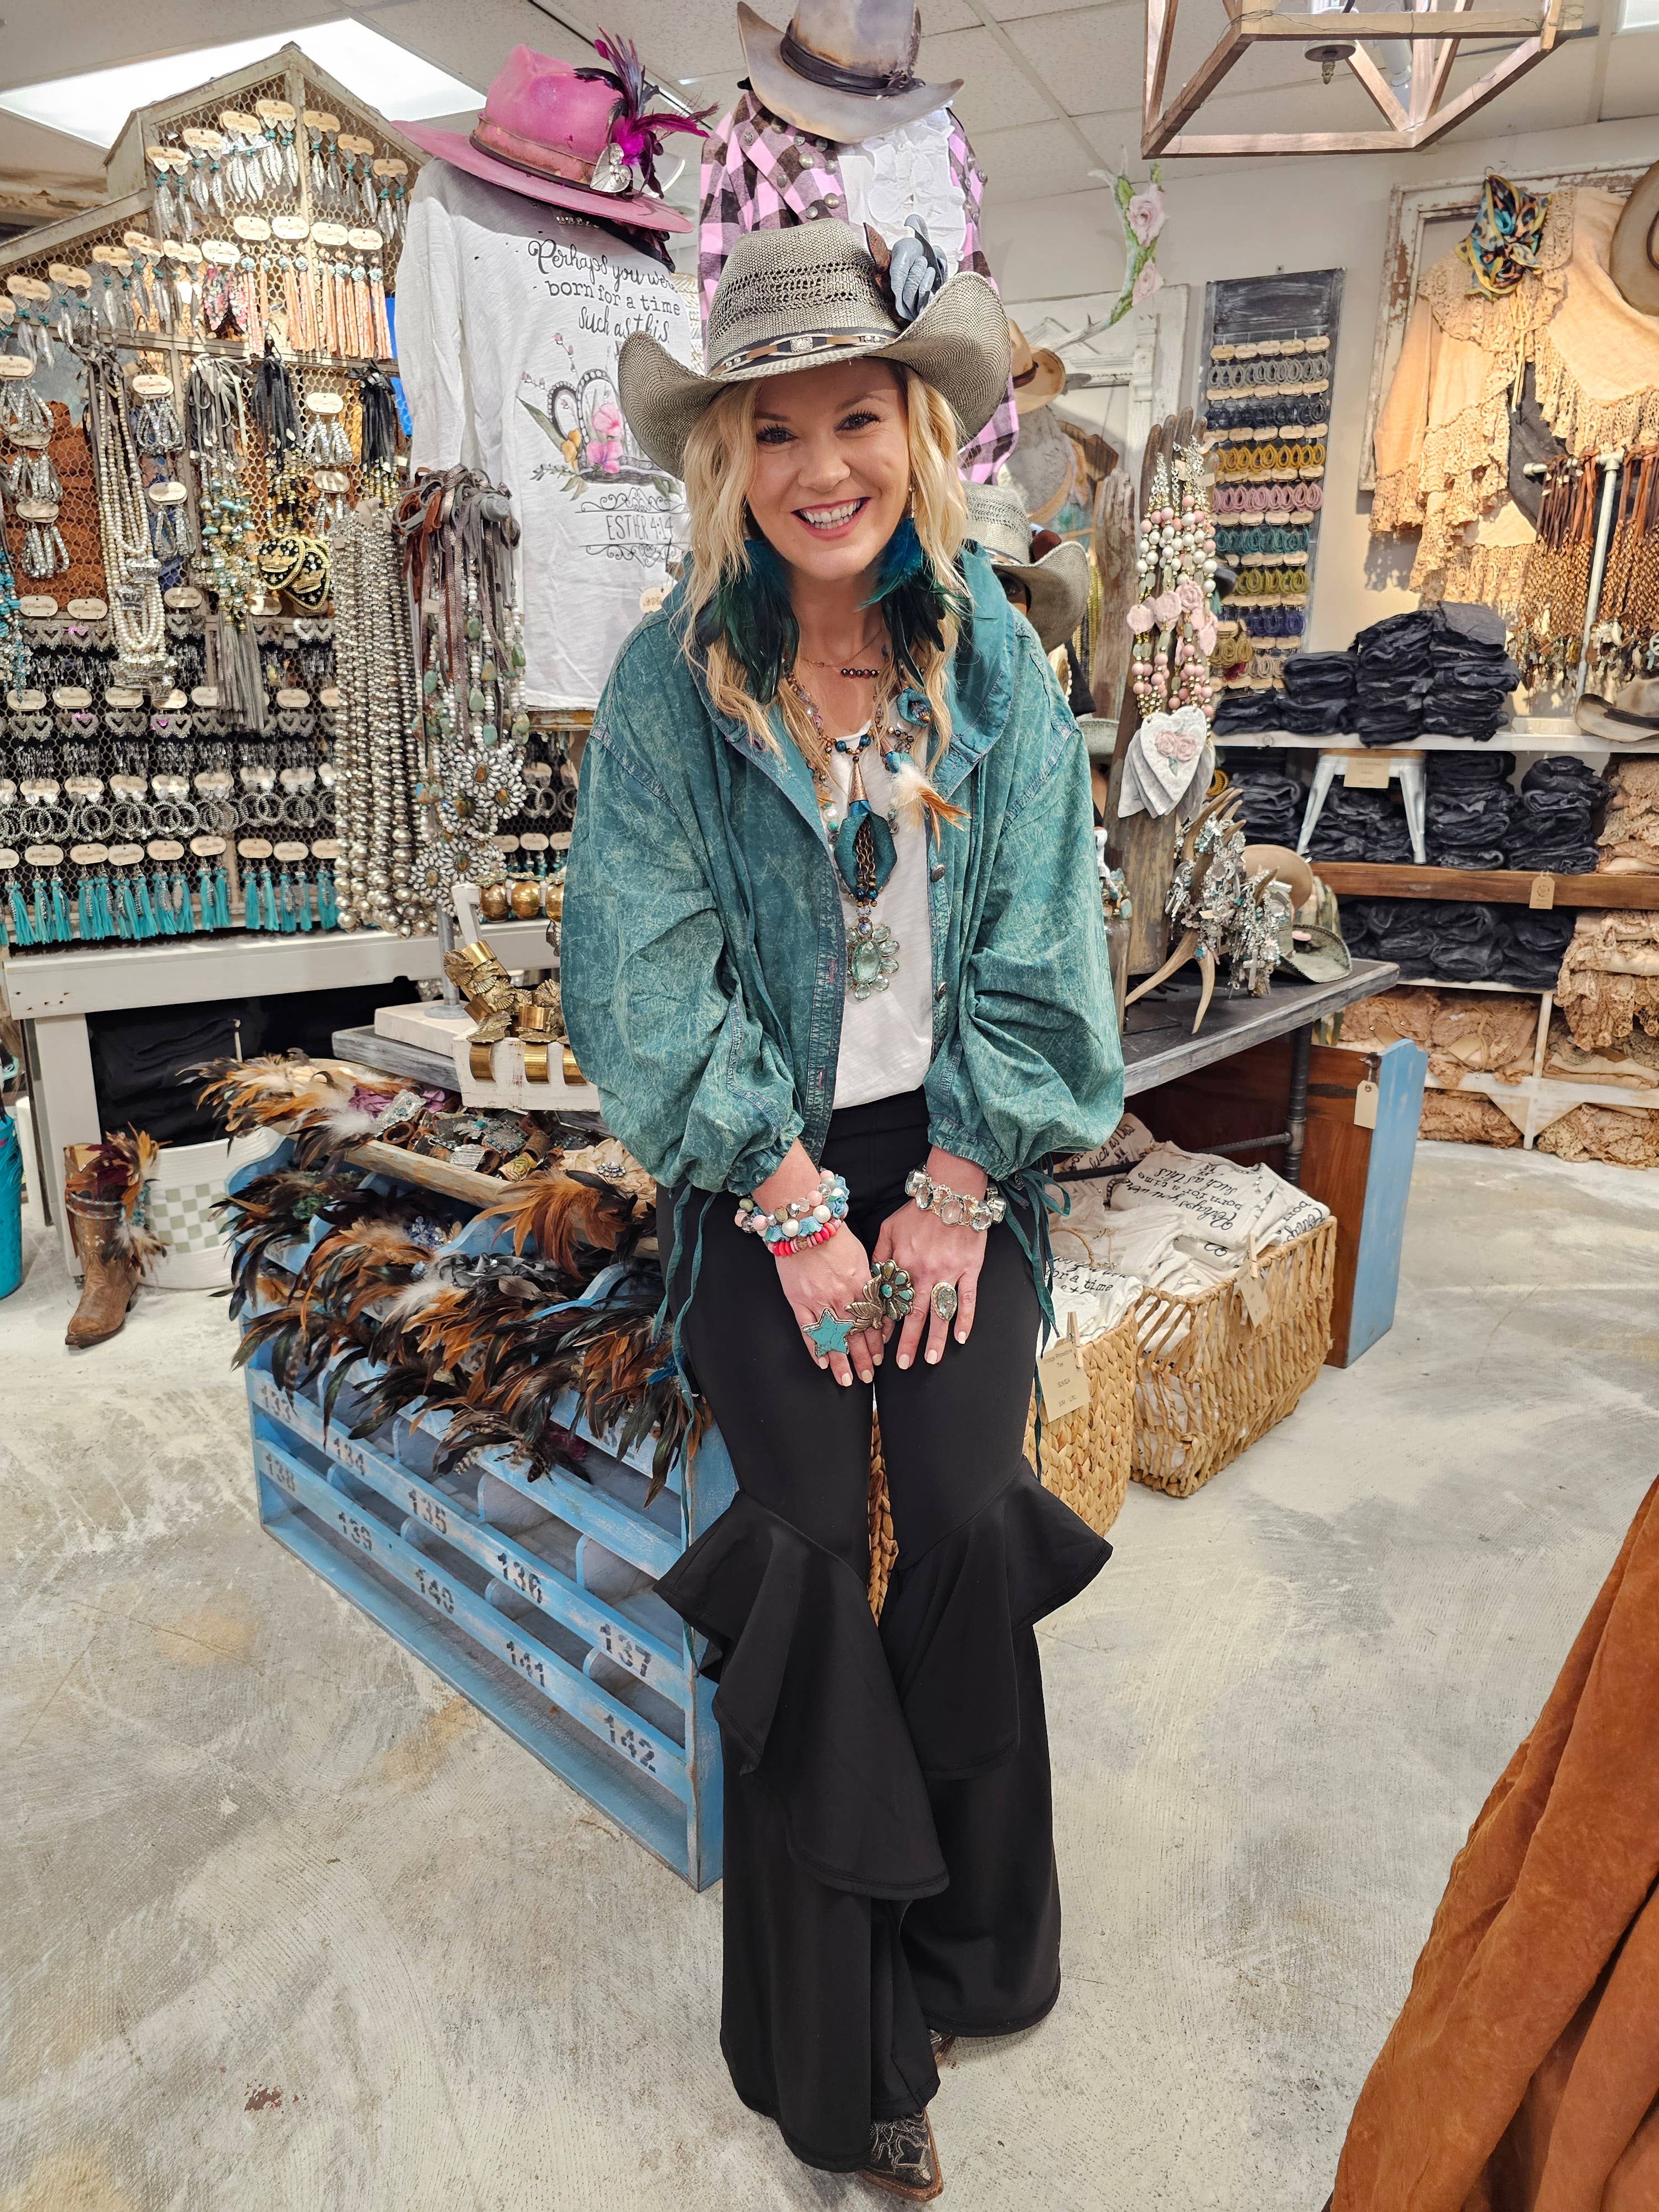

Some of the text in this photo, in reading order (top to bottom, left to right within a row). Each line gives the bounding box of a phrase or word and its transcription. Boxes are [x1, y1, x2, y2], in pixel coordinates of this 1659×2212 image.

[528, 239, 608, 285] Perhaps
[612, 265, 645, 292] you
[545, 280, 681, 316] born for a time
[578, 305, 609, 336] such
[614, 317, 630, 338] as
[606, 515, 674, 540] ESTHER 4:14
[1138, 1171, 1168, 1188] time
[1183, 1188, 1205, 1199] for
[1185, 1176, 1204, 1185] as
[1199, 1178, 1238, 1196] such
[1176, 1199, 1238, 1230] Perhaps
[1210, 1195, 1243, 1211] born
[1070, 1275, 1079, 1284] a
[1084, 1277, 1114, 1292] time
[265, 1453, 295, 1491] 138
[333, 1437, 365, 1476] 134
[408, 1488, 447, 1535] 135
[338, 1511, 372, 1551] 139
[416, 1568, 454, 1614] 140
[498, 1552, 543, 1604] 136
[507, 1641, 545, 1687] 141
[600, 1623, 651, 1677] 137
[604, 1714, 656, 1773] 142
